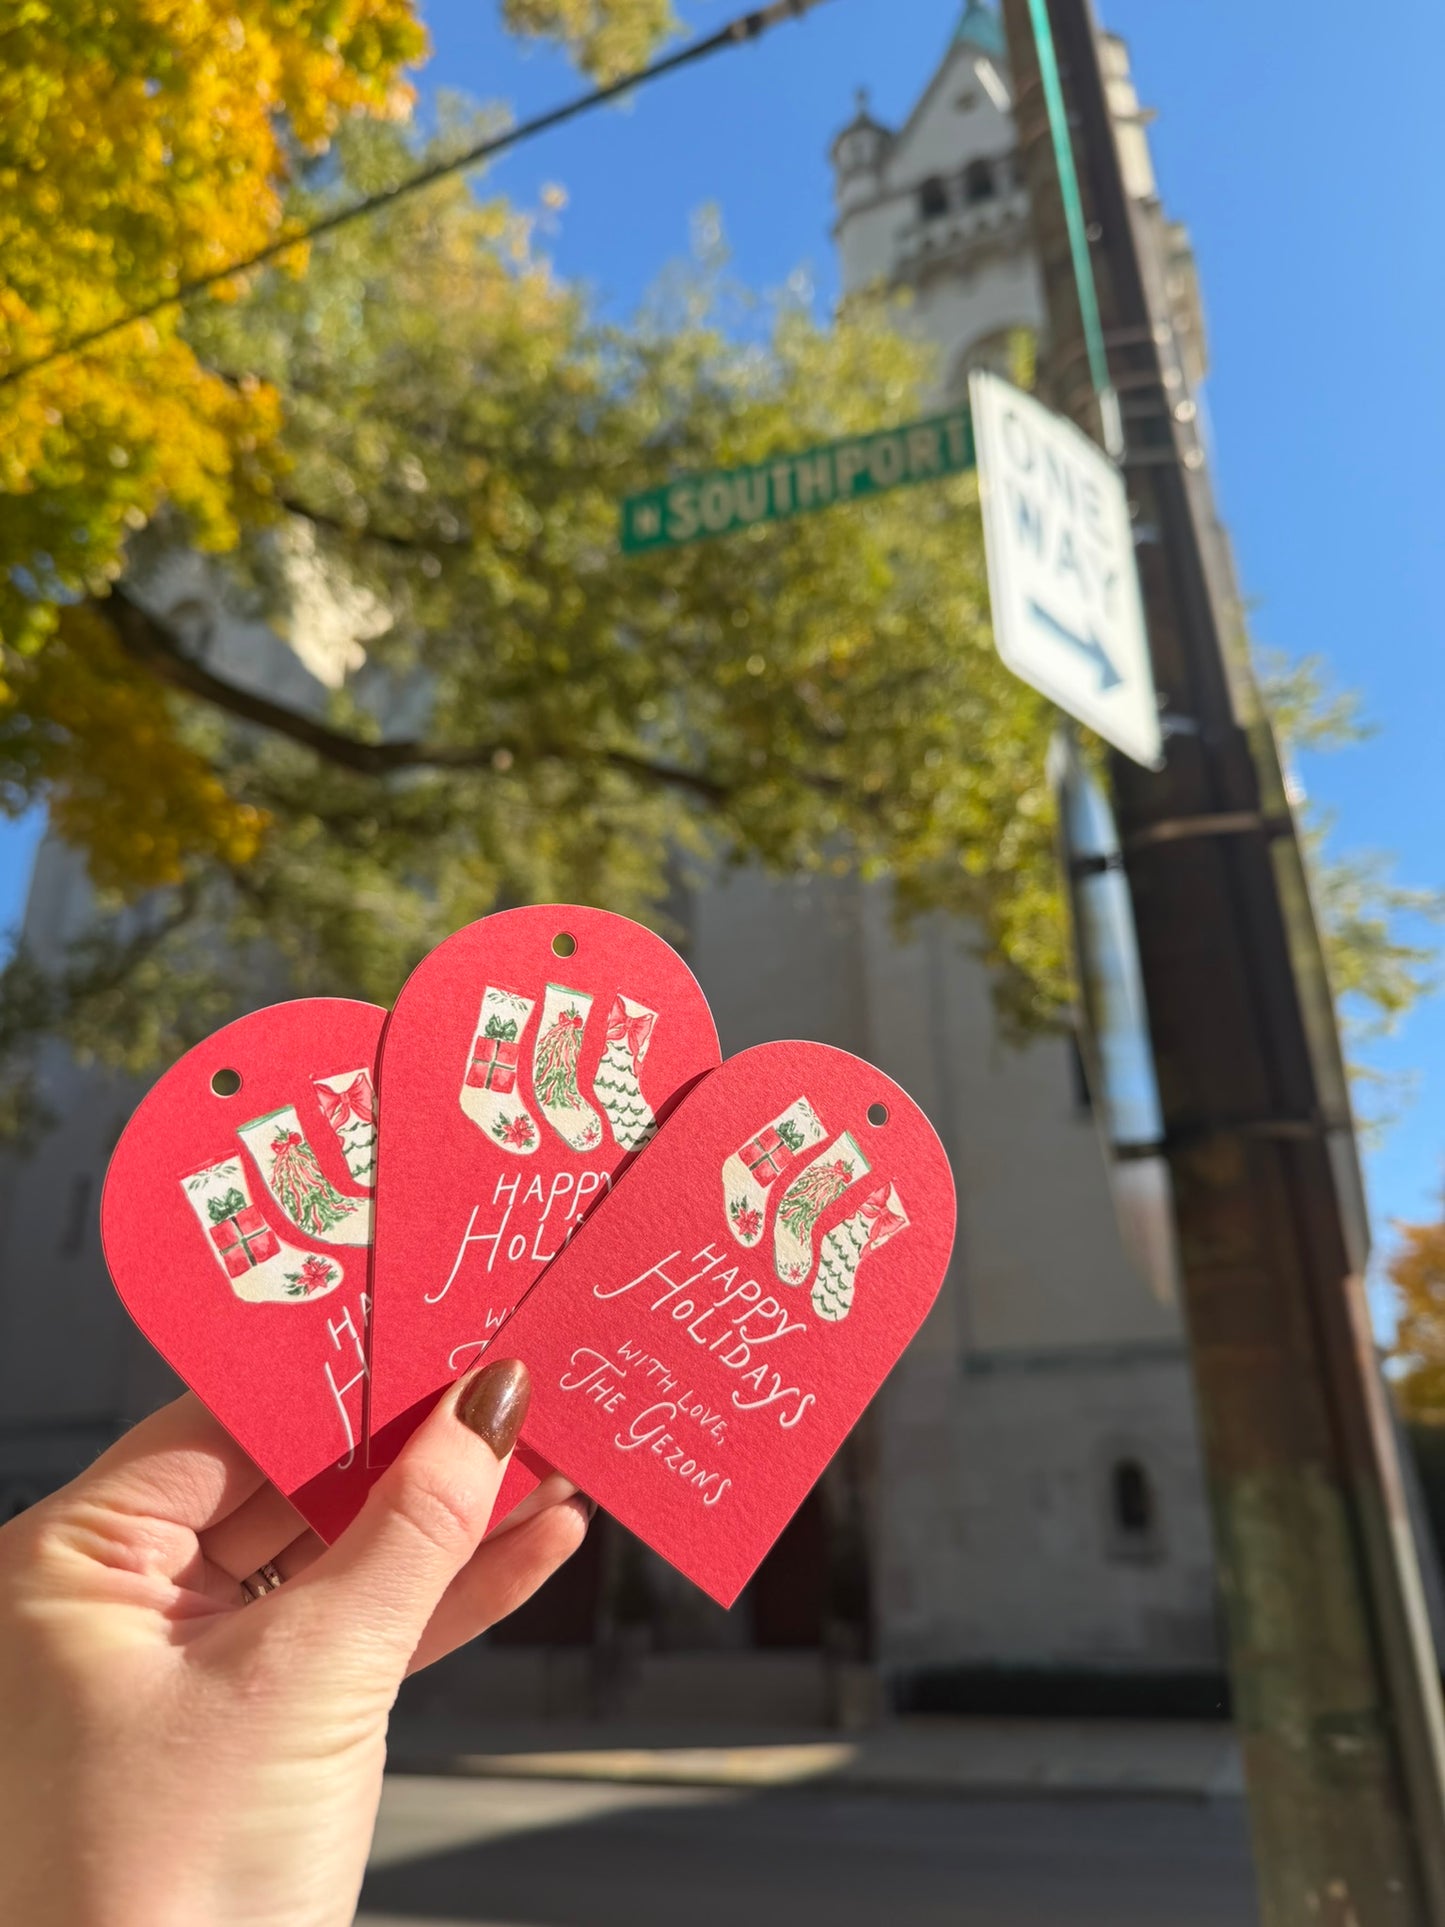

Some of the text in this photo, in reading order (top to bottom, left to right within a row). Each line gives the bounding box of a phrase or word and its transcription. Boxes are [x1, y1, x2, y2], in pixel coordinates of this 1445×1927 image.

[666, 417, 970, 541] SOUTHPORT
[1001, 409, 1113, 549] ONE
[1007, 481, 1120, 621] WAY
[692, 1243, 807, 1344] HAPPY
[560, 1348, 732, 1505] THE GEZONS
[617, 1340, 728, 1445] WITH LOVE,
